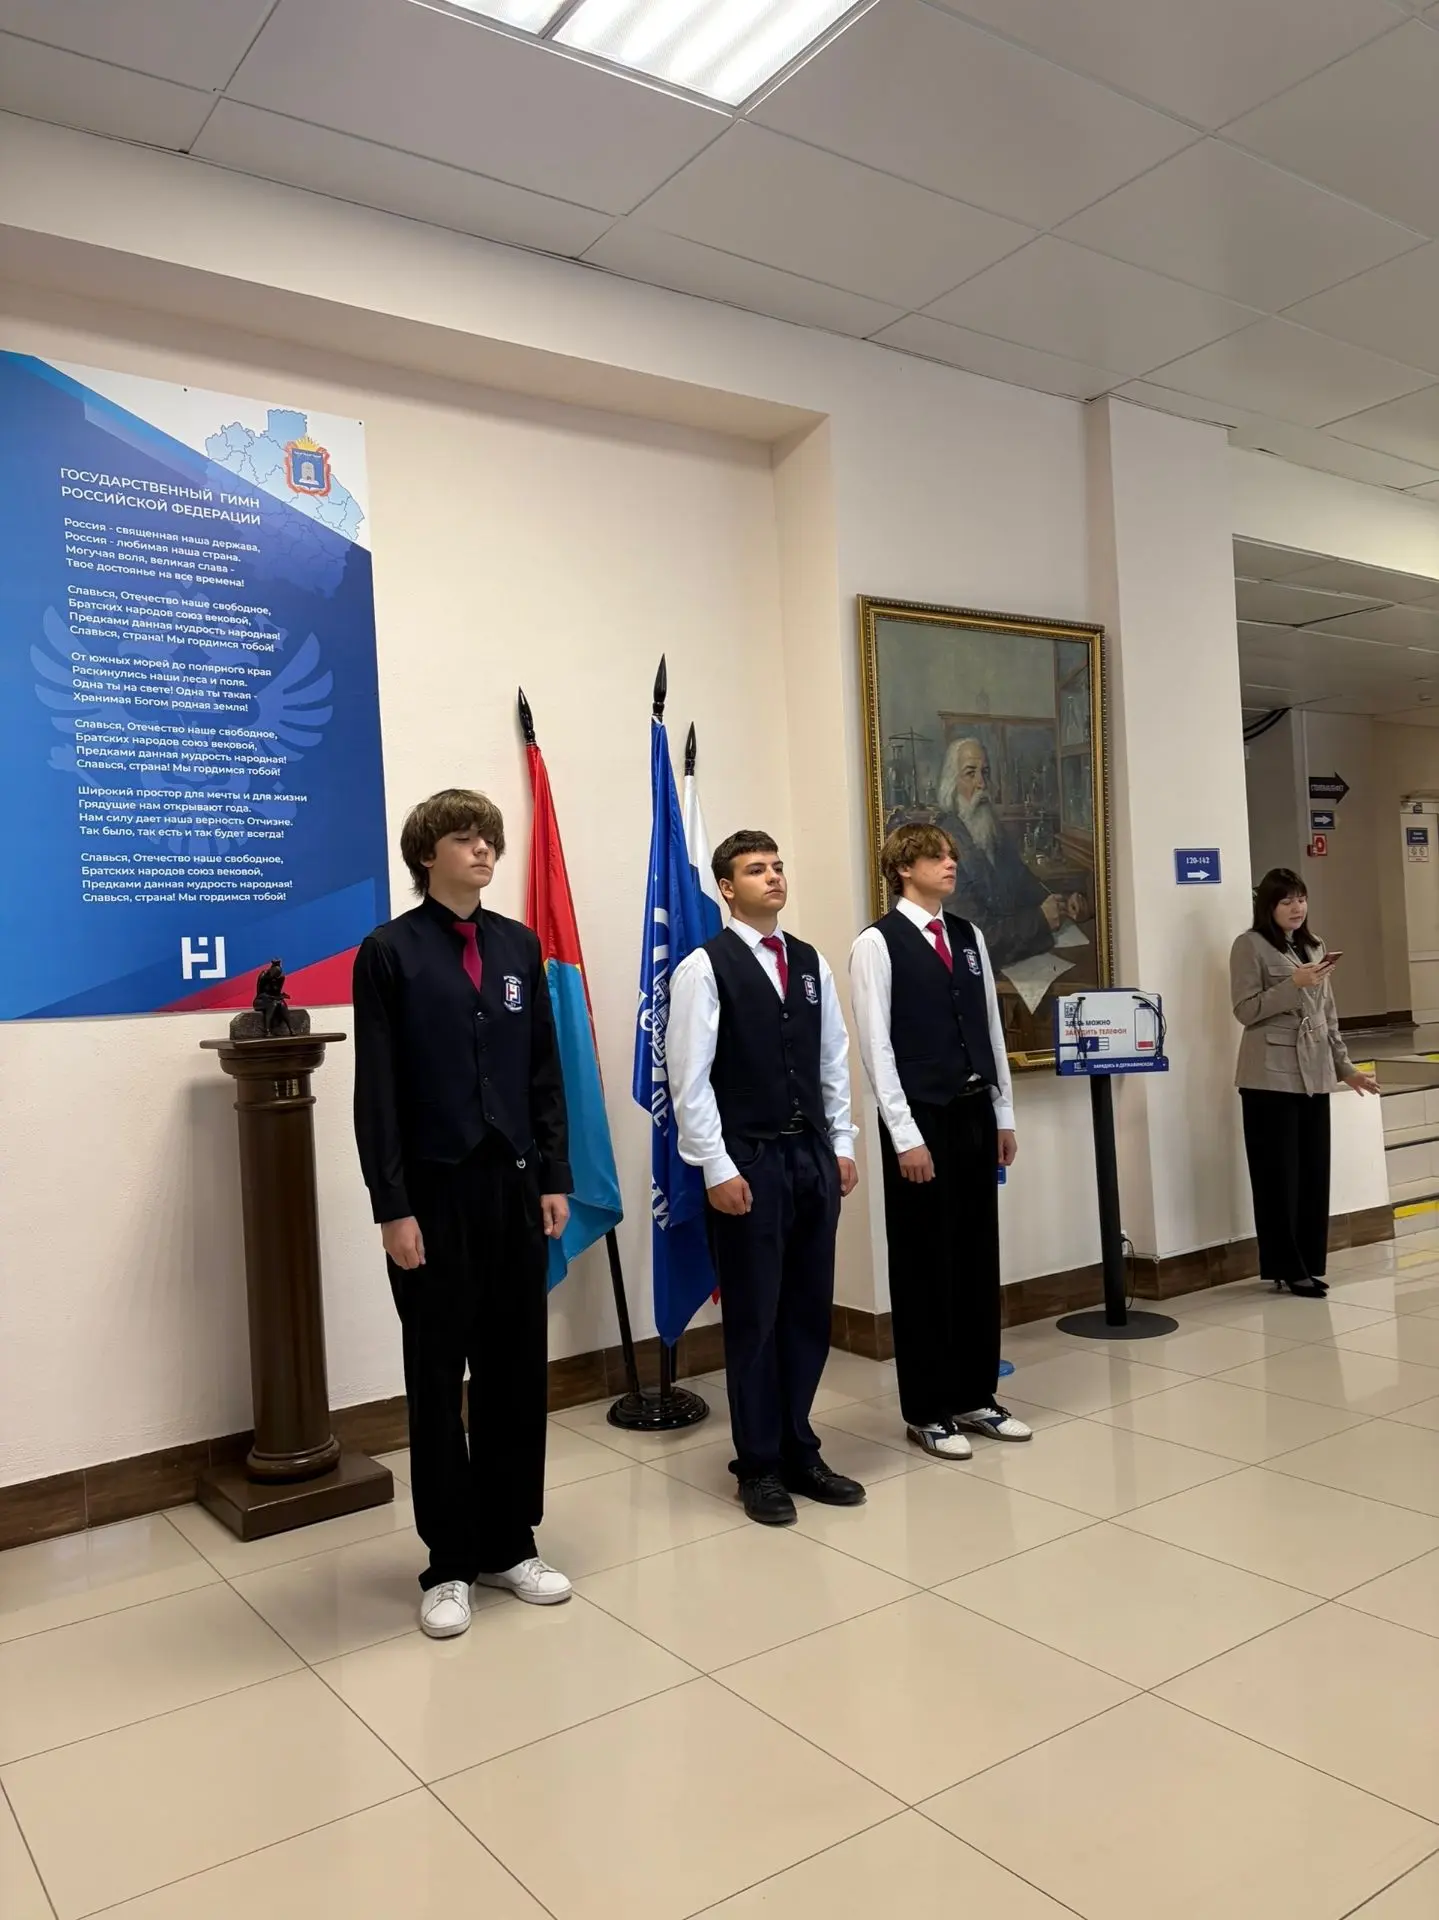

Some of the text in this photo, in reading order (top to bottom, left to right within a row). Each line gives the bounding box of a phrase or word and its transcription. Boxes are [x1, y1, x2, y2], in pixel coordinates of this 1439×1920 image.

[60, 468, 259, 508] ГОСУДАРСТВЕННЫЙ ГИМН
[62, 486, 260, 524] РОССИЙСКОЙ ФЕДЕРАЦИИ
[64, 518, 106, 531] Россия
[116, 527, 178, 541] священная
[181, 536, 210, 545] наша
[212, 540, 260, 552] держава,
[65, 531, 107, 544] Россия
[116, 540, 168, 552] любимая
[171, 547, 200, 557] наша
[202, 551, 241, 562] страна.
[66, 544, 115, 559] Могучая
[118, 553, 148, 564] воля,
[150, 557, 196, 568] великая
[198, 563, 228, 573] слава
[66, 558, 94, 569] Твое
[96, 564, 156, 576] достоянье
[174, 573, 193, 581] все
[196, 575, 244, 587] времена!
[67, 585, 271, 616] Славься, Отечество наше свободное,
[68, 598, 252, 626] Братских народов союз вековой,
[69, 612, 280, 640] Предками данная мудрость народная!
[70, 625, 274, 652] Славься, страна! Мы гордимся тобой!
[71, 652, 272, 677] От южных морей до полярного края
[72, 665, 148, 679] Раскинулись
[150, 673, 180, 681] наши
[182, 676, 208, 684] леса
[220, 678, 248, 687] поля.
[72, 679, 103, 689] Одна
[140, 685, 173, 694] свете!
[176, 686, 204, 696] Одна
[222, 691, 252, 700] такая
[74, 692, 248, 712] Хранимая Богом родная земля!
[74, 719, 125, 731] Славься,
[127, 722, 185, 733] Отечество
[218, 728, 278, 739] свободное,
[76, 732, 258, 751] Братских народов союз вековой,
[76, 746, 286, 764] Предками данная мудрость народная!
[76, 759, 280, 776] Славься, страна! Мы гордимся тобой!
[78, 786, 134, 796] Широкий
[136, 789, 182, 799] простор
[79, 799, 136, 810] Грядущие
[163, 803, 223, 812] открывают
[225, 805, 252, 813] года.
[79, 813, 104, 822] Нам
[106, 815, 134, 824] силу
[135, 816, 161, 824] дает
[196, 817, 245, 826] верность
[246, 817, 293, 826] Отчизне.
[80, 826, 100, 835] Так
[102, 826, 135, 836] было,
[214, 828, 244, 839] будет
[247, 830, 284, 839] всегда!
[81, 853, 131, 862] Славься,
[133, 853, 191, 862] Отечество
[224, 854, 284, 864] свободное,
[82, 866, 135, 876] Братских
[138, 868, 185, 877] народов
[217, 867, 263, 876] вековой,
[82, 880, 142, 890] Предками
[186, 881, 238, 890] мудрость
[240, 881, 292, 889] народная!
[82, 892, 286, 903] Славься, страна! Мы гордимся тобой!
